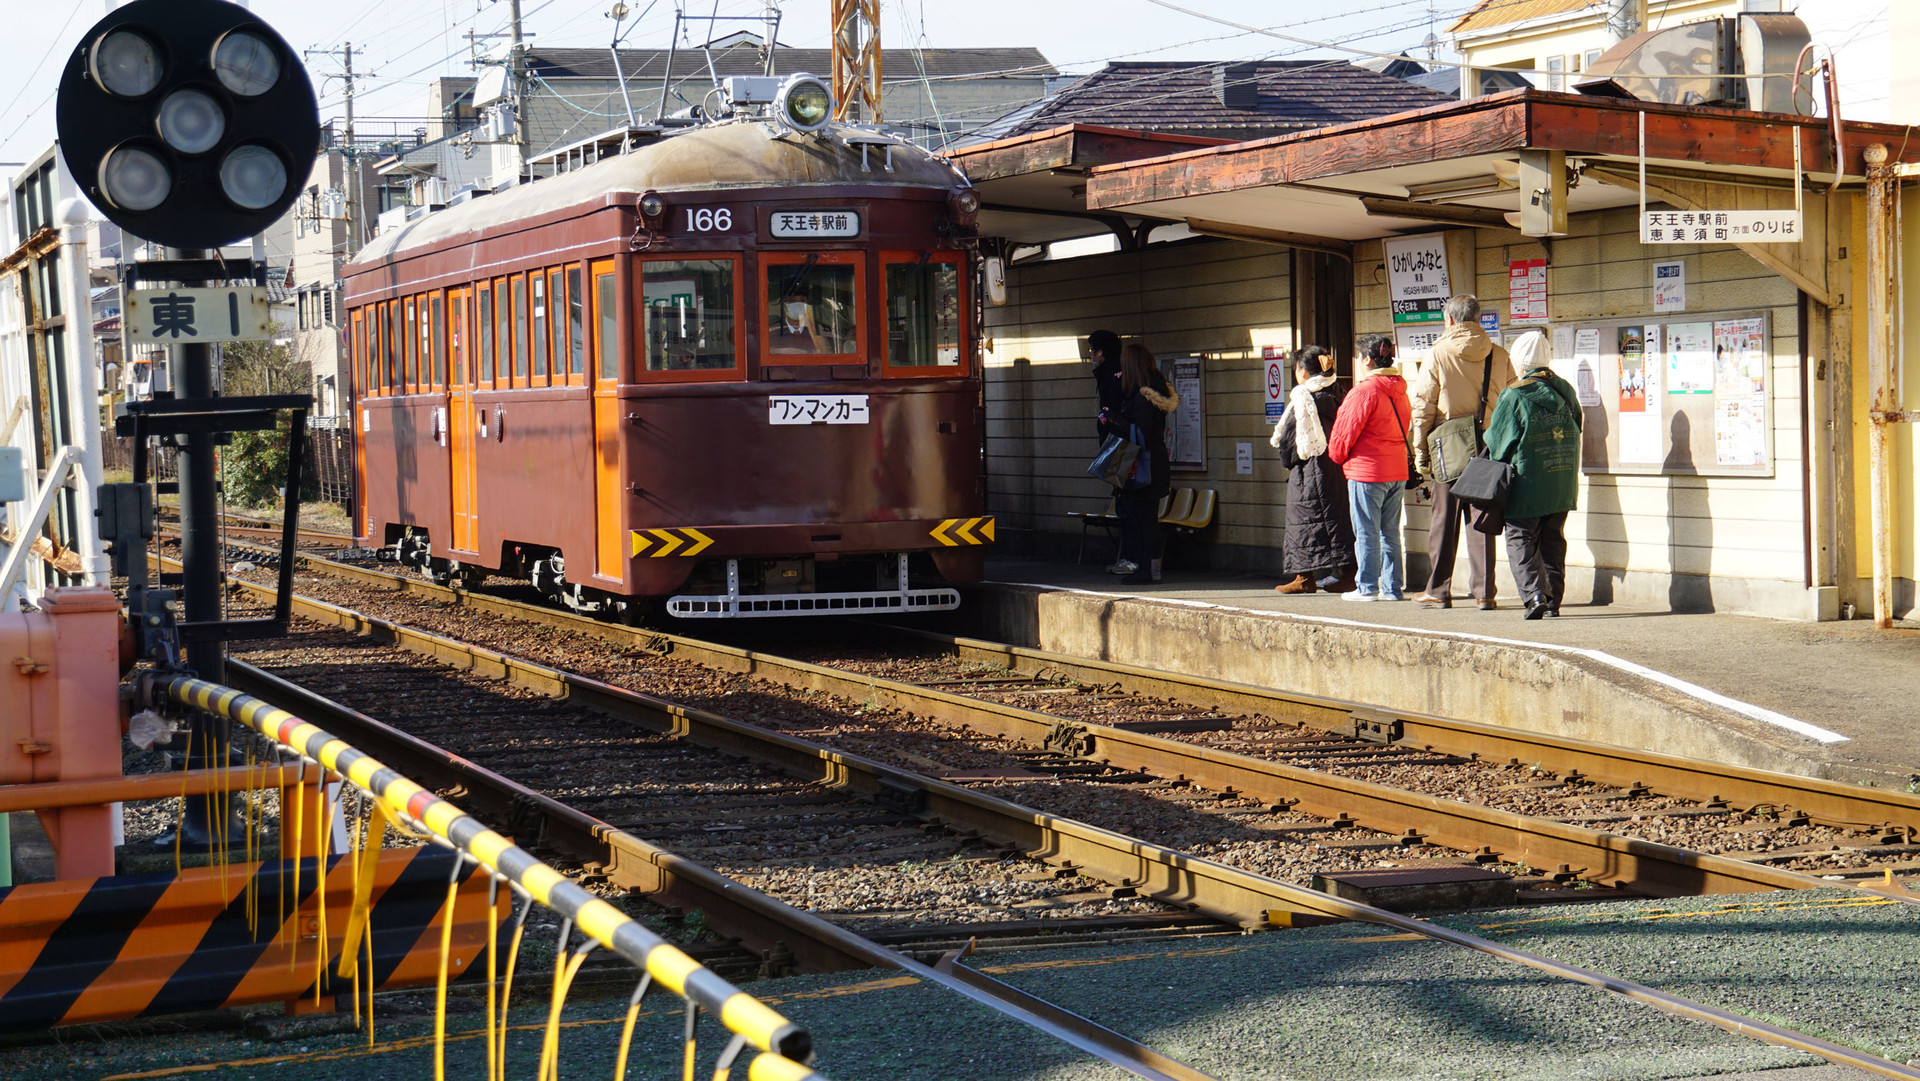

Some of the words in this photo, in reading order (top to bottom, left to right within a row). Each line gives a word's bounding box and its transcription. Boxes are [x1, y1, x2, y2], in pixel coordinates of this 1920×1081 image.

[686, 208, 732, 232] 166
[780, 215, 848, 231] 天王寺駅前
[1649, 213, 1728, 227] 天王寺駅前
[1752, 220, 1794, 234] のりば
[1650, 228, 1728, 241] 恵美須町
[1392, 249, 1443, 273] ひがしみなと
[1402, 285, 1439, 296] HIGASHI-MINATO
[773, 399, 864, 420] ワンマンカー
